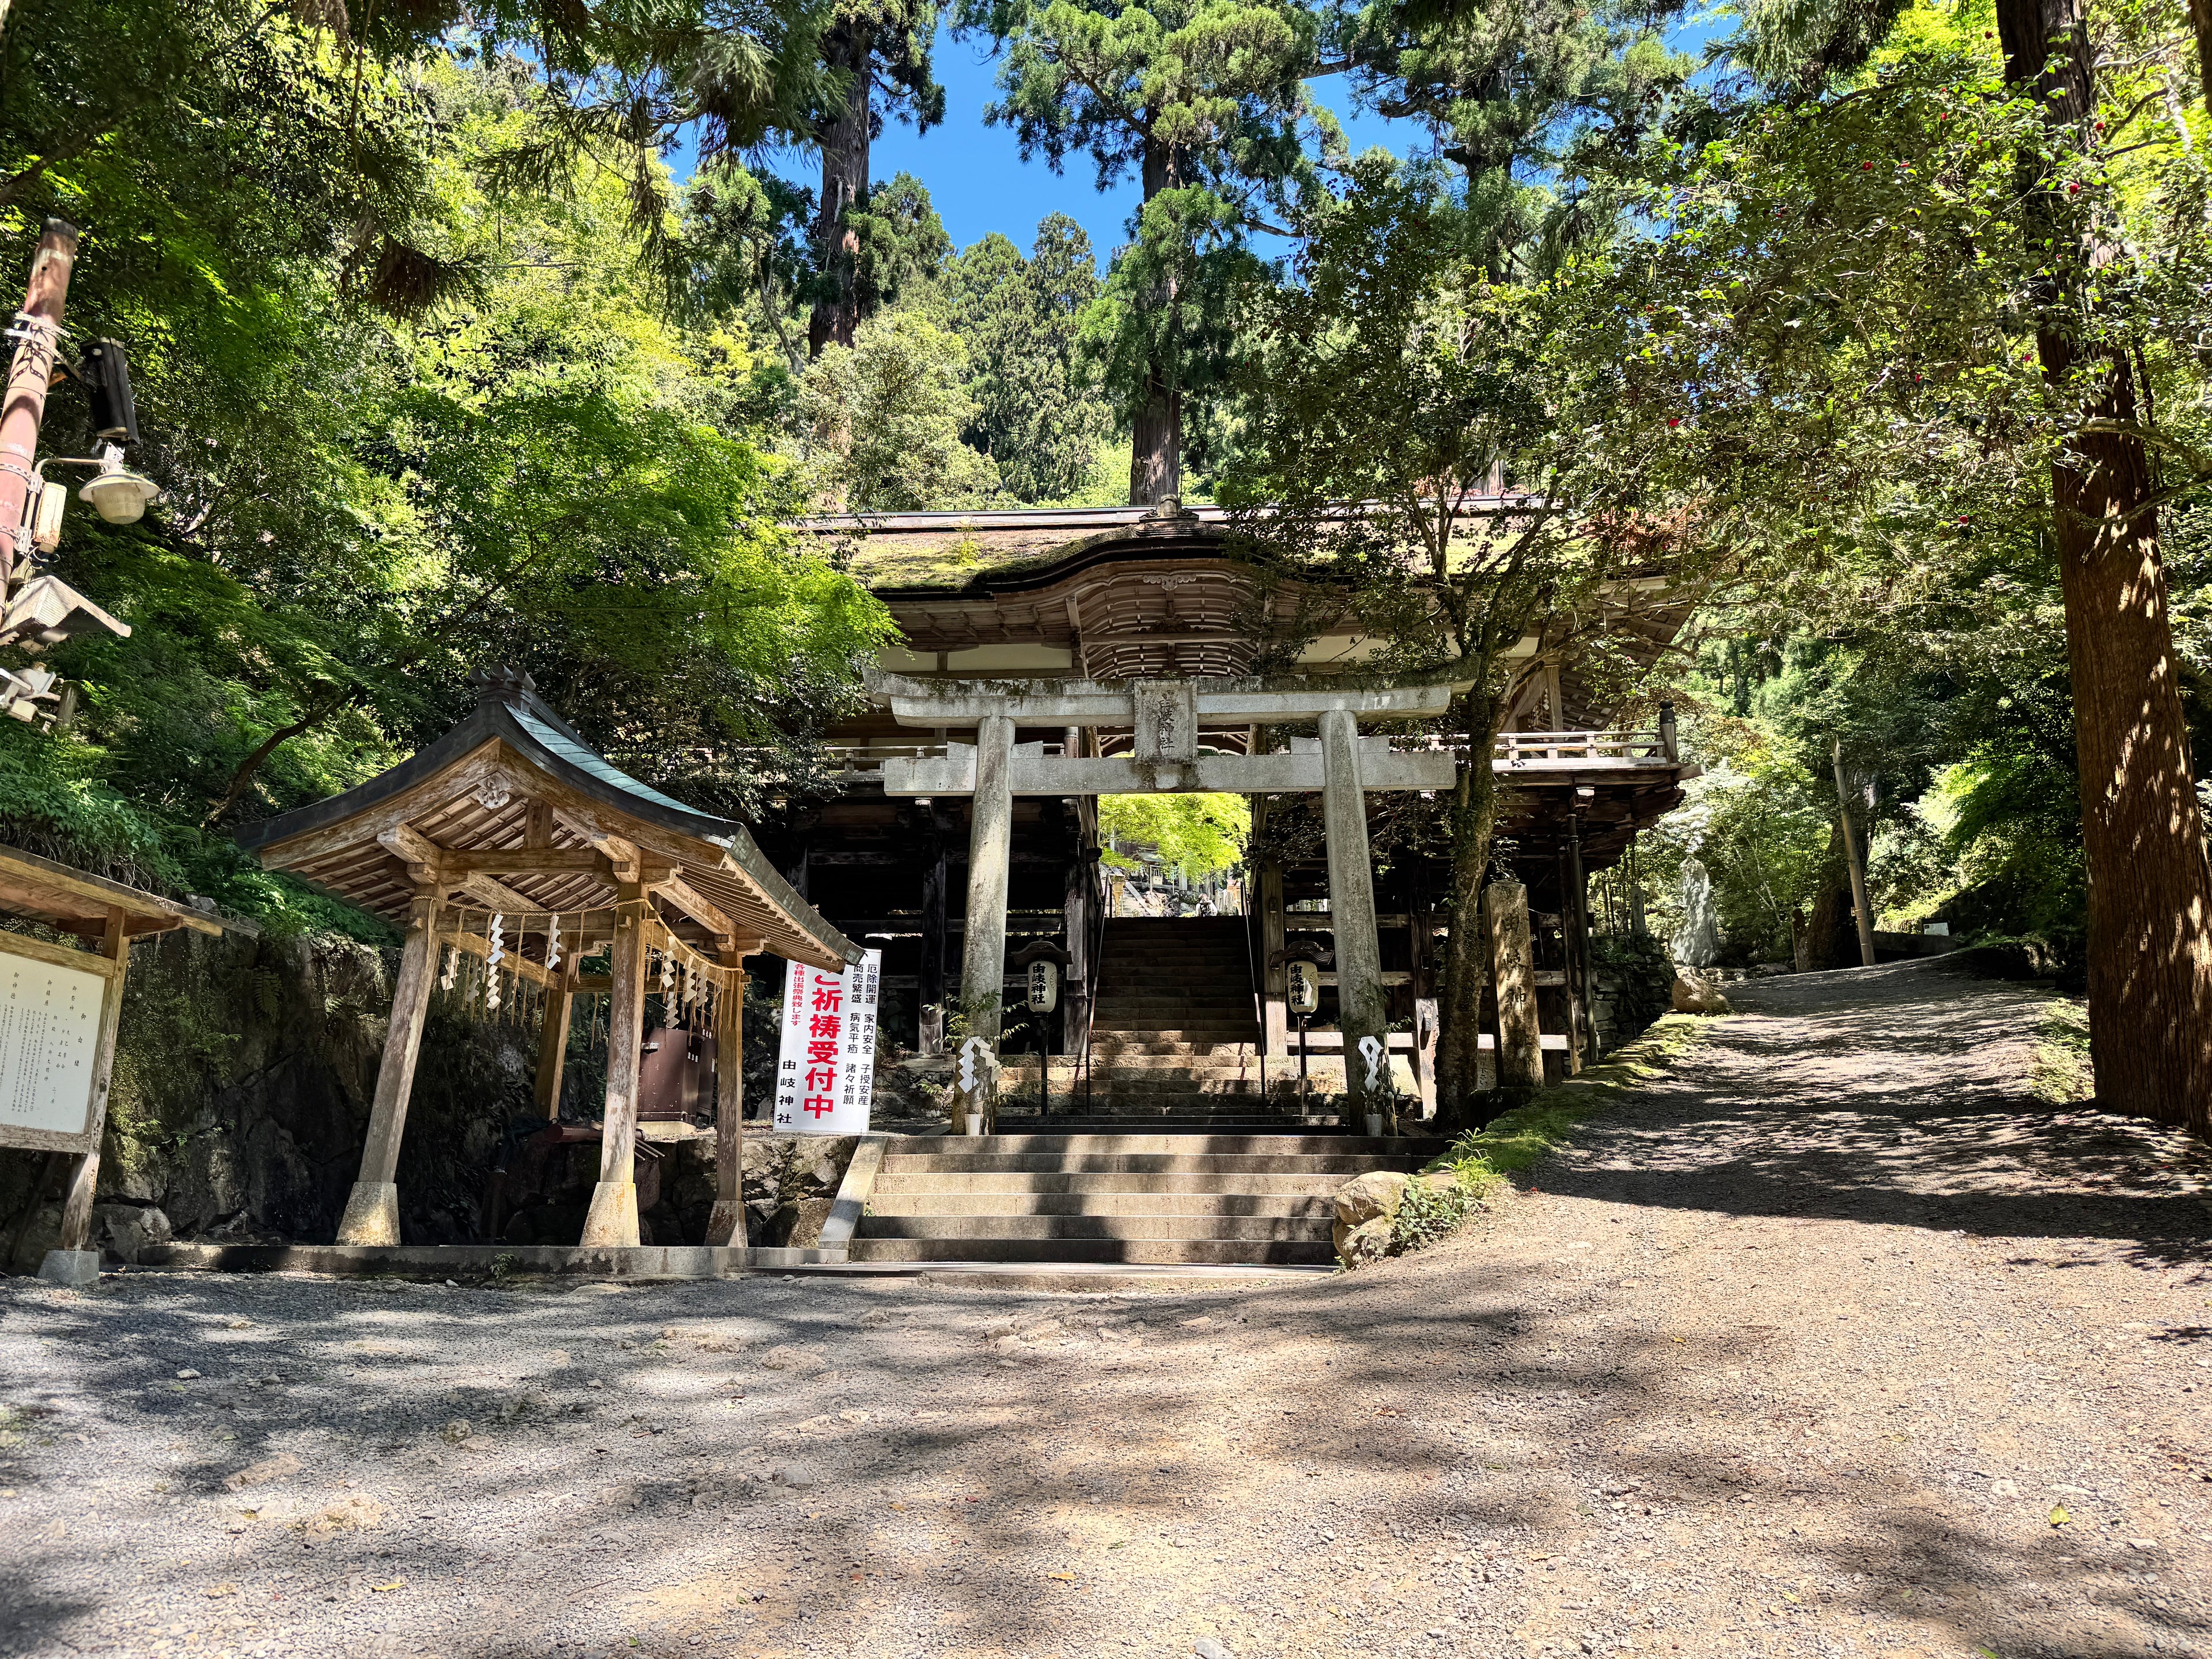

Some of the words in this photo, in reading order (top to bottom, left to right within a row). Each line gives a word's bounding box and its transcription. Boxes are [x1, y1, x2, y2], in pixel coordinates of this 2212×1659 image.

[790, 964, 805, 1027] 各種出張祭典致します
[851, 964, 864, 1003] 商売繁盛
[865, 964, 878, 1004] 厄除開運
[1031, 963, 1046, 1005] 由岐神社
[1290, 964, 1305, 1006] 由岐神社
[847, 1012, 861, 1054] 病気平癒
[862, 1013, 874, 1055] 家内安全
[777, 1060, 796, 1124] 由岐神社
[843, 1063, 857, 1105] 諸々祈願
[858, 1064, 872, 1105] 子授安産
